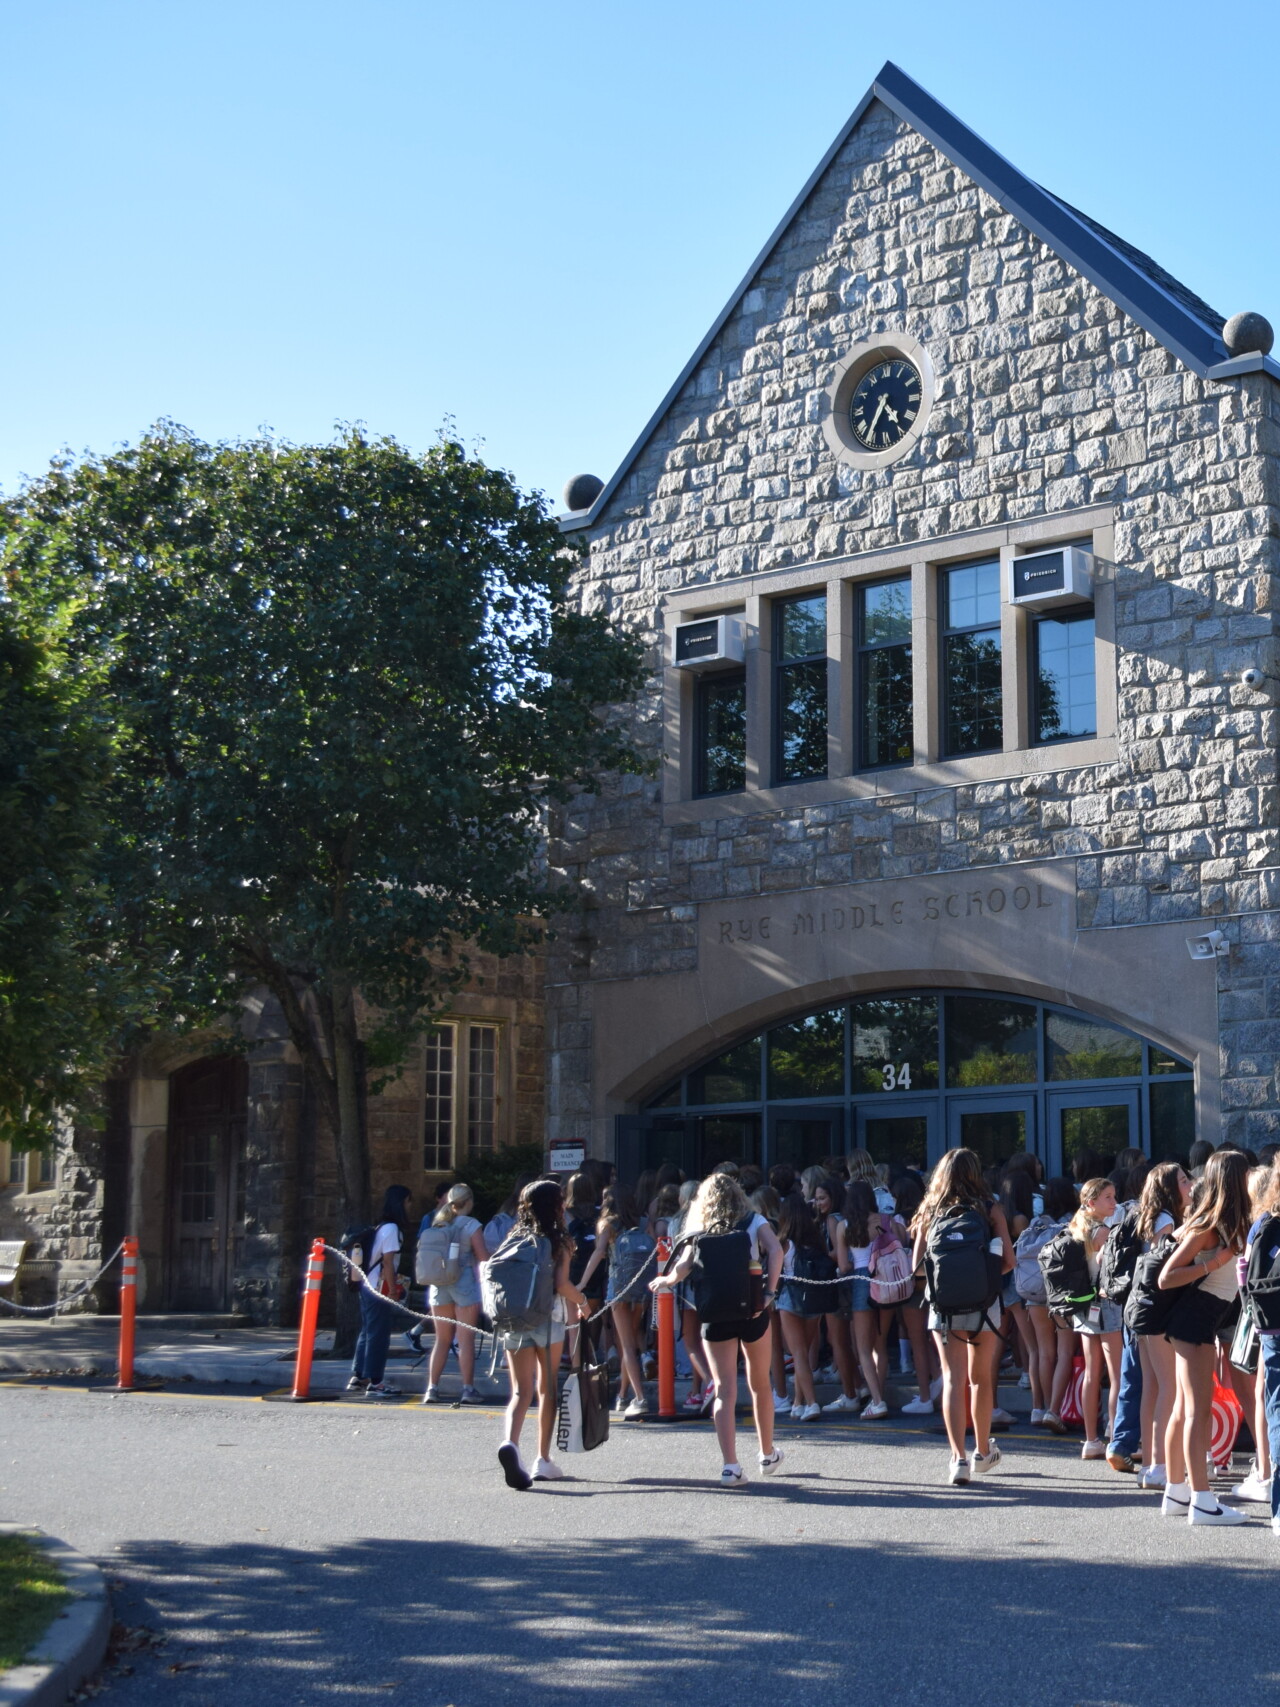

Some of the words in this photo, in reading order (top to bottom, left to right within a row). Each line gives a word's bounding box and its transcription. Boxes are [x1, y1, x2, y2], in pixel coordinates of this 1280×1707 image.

[1030, 569, 1057, 577] FRIEDRICH
[718, 916, 771, 945] RYE
[792, 901, 905, 936] MIDDLE
[922, 883, 1053, 921] SCHOOL
[882, 1062, 912, 1091] 34
